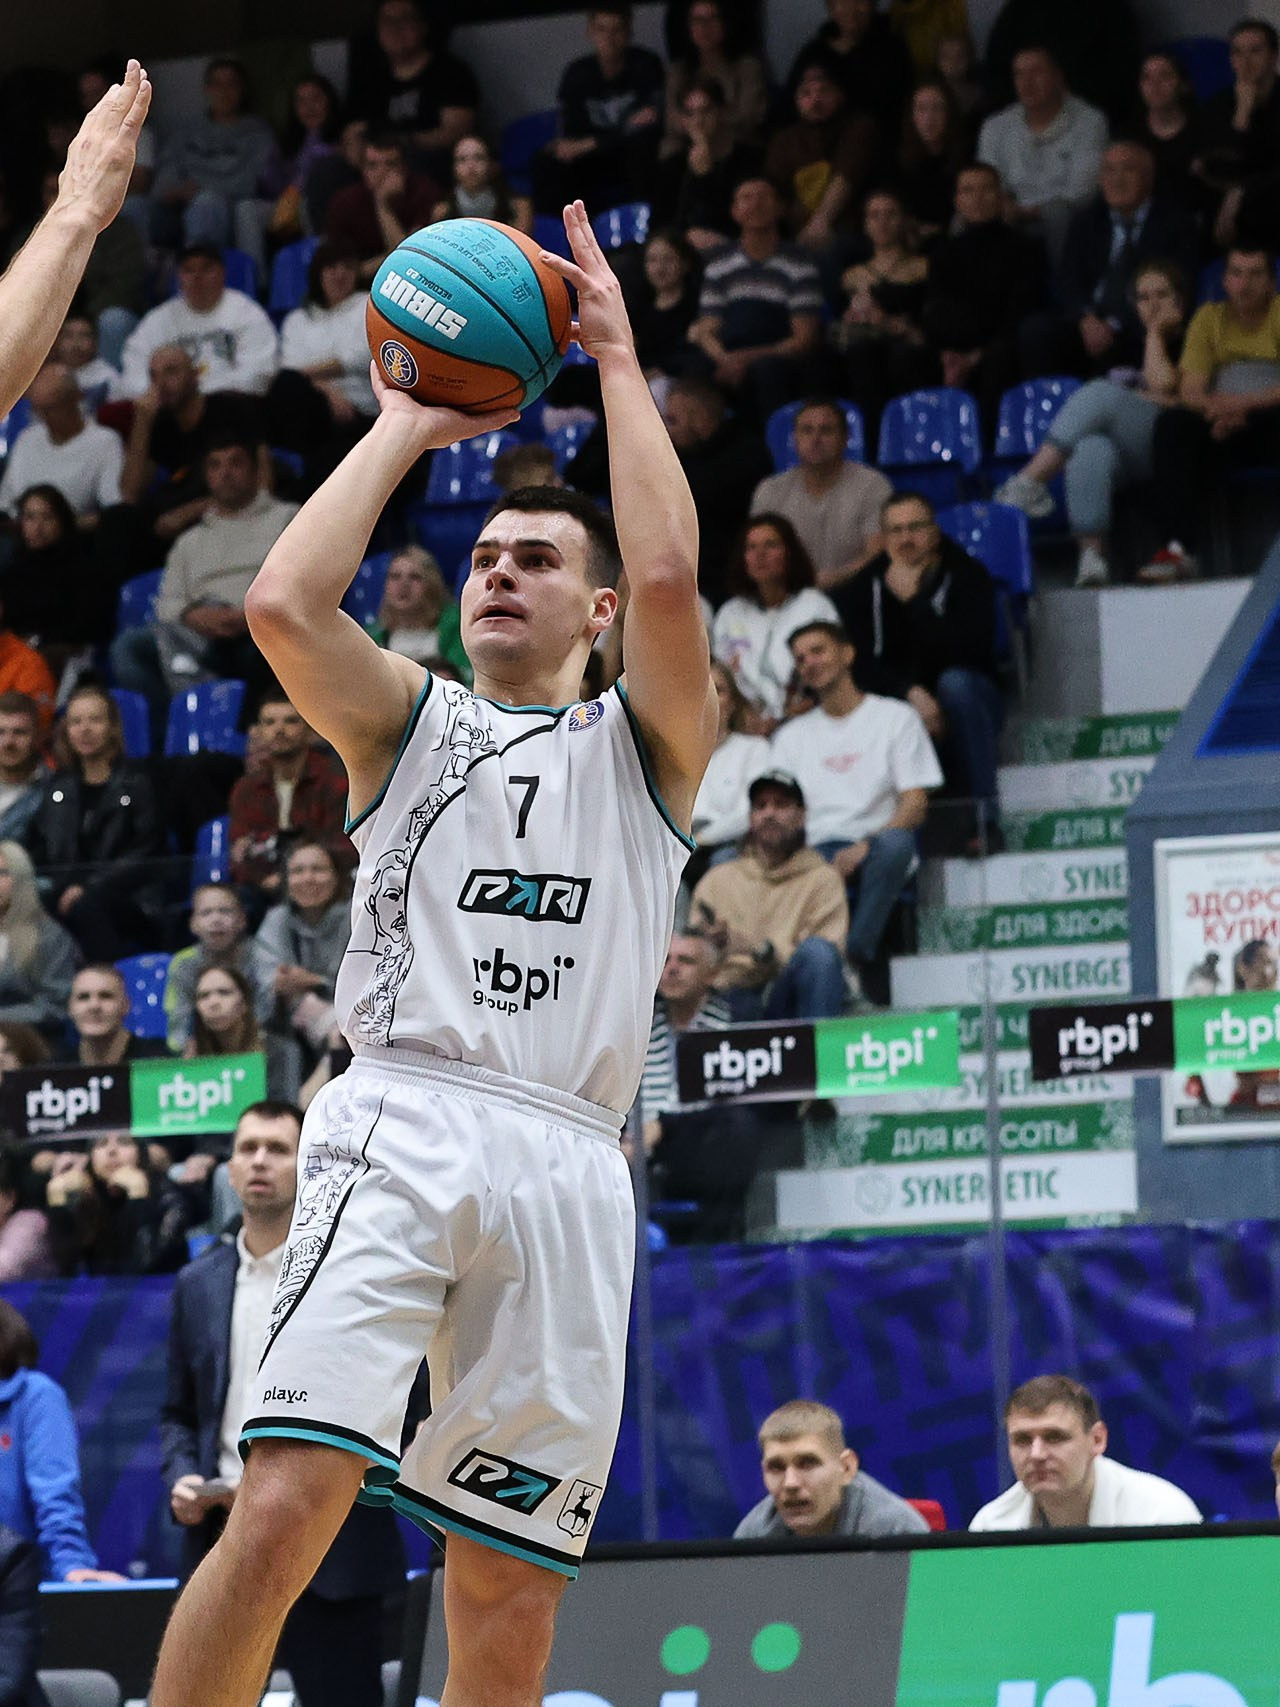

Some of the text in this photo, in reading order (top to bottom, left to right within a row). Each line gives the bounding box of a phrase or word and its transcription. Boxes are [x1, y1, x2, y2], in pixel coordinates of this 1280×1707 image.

[379, 270, 468, 340] SIBUR
[508, 775, 540, 839] 7
[462, 875, 583, 918] PARI
[1064, 863, 1128, 893] SYNE
[1186, 885, 1280, 918] ЗДОРО
[472, 947, 575, 1011] rbpi
[1011, 957, 1122, 993] SYNERGE
[472, 989, 519, 1017] goup
[703, 1035, 796, 1088] rbpi
[845, 1026, 938, 1077] rbpi
[1058, 1011, 1153, 1066] rbpi
[26, 1074, 114, 1126] rbpi
[158, 1068, 246, 1117] rbpi
[891, 1120, 1079, 1157] ДЛЯ КРСОТЫ
[901, 1166, 1061, 1207] SYNERETIC
